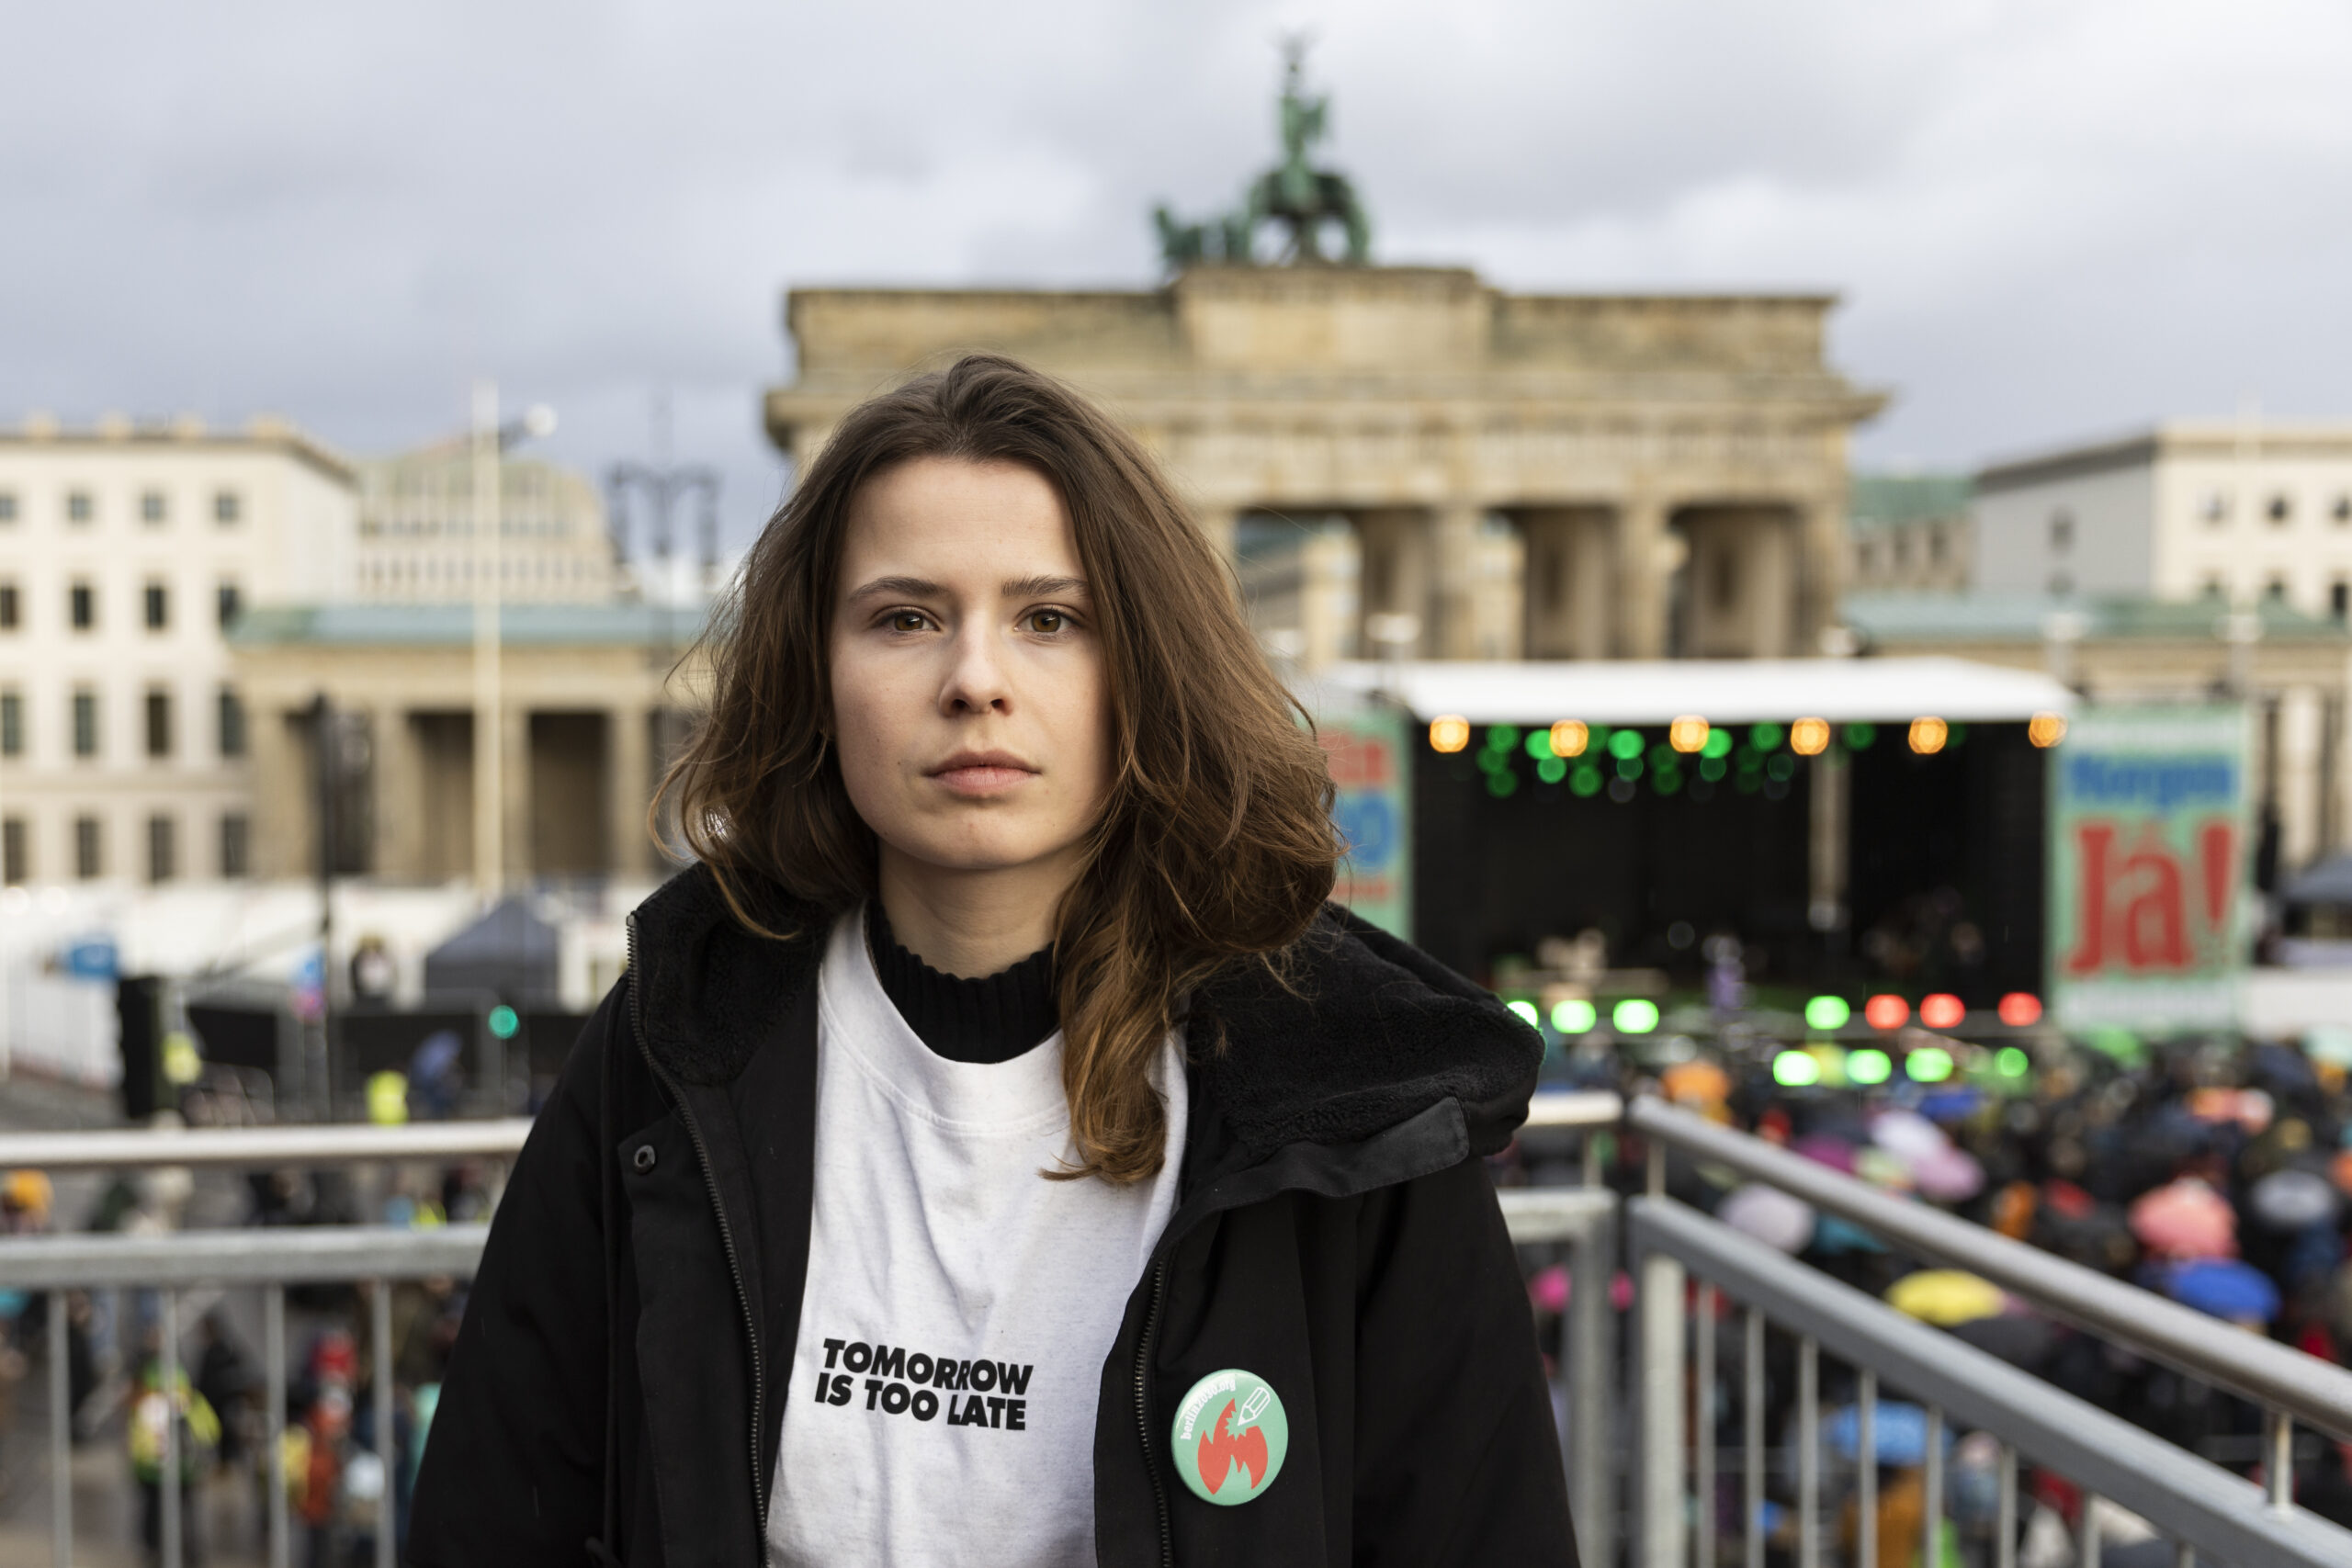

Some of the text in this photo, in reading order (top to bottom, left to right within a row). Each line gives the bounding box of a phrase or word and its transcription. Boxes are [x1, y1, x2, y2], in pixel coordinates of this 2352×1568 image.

[2067, 823, 2233, 976] Ja!
[823, 1338, 1034, 1394] TOMORROW
[815, 1372, 1026, 1430] IS TOO LATE
[1180, 1377, 1237, 1440] berlin2030.org
